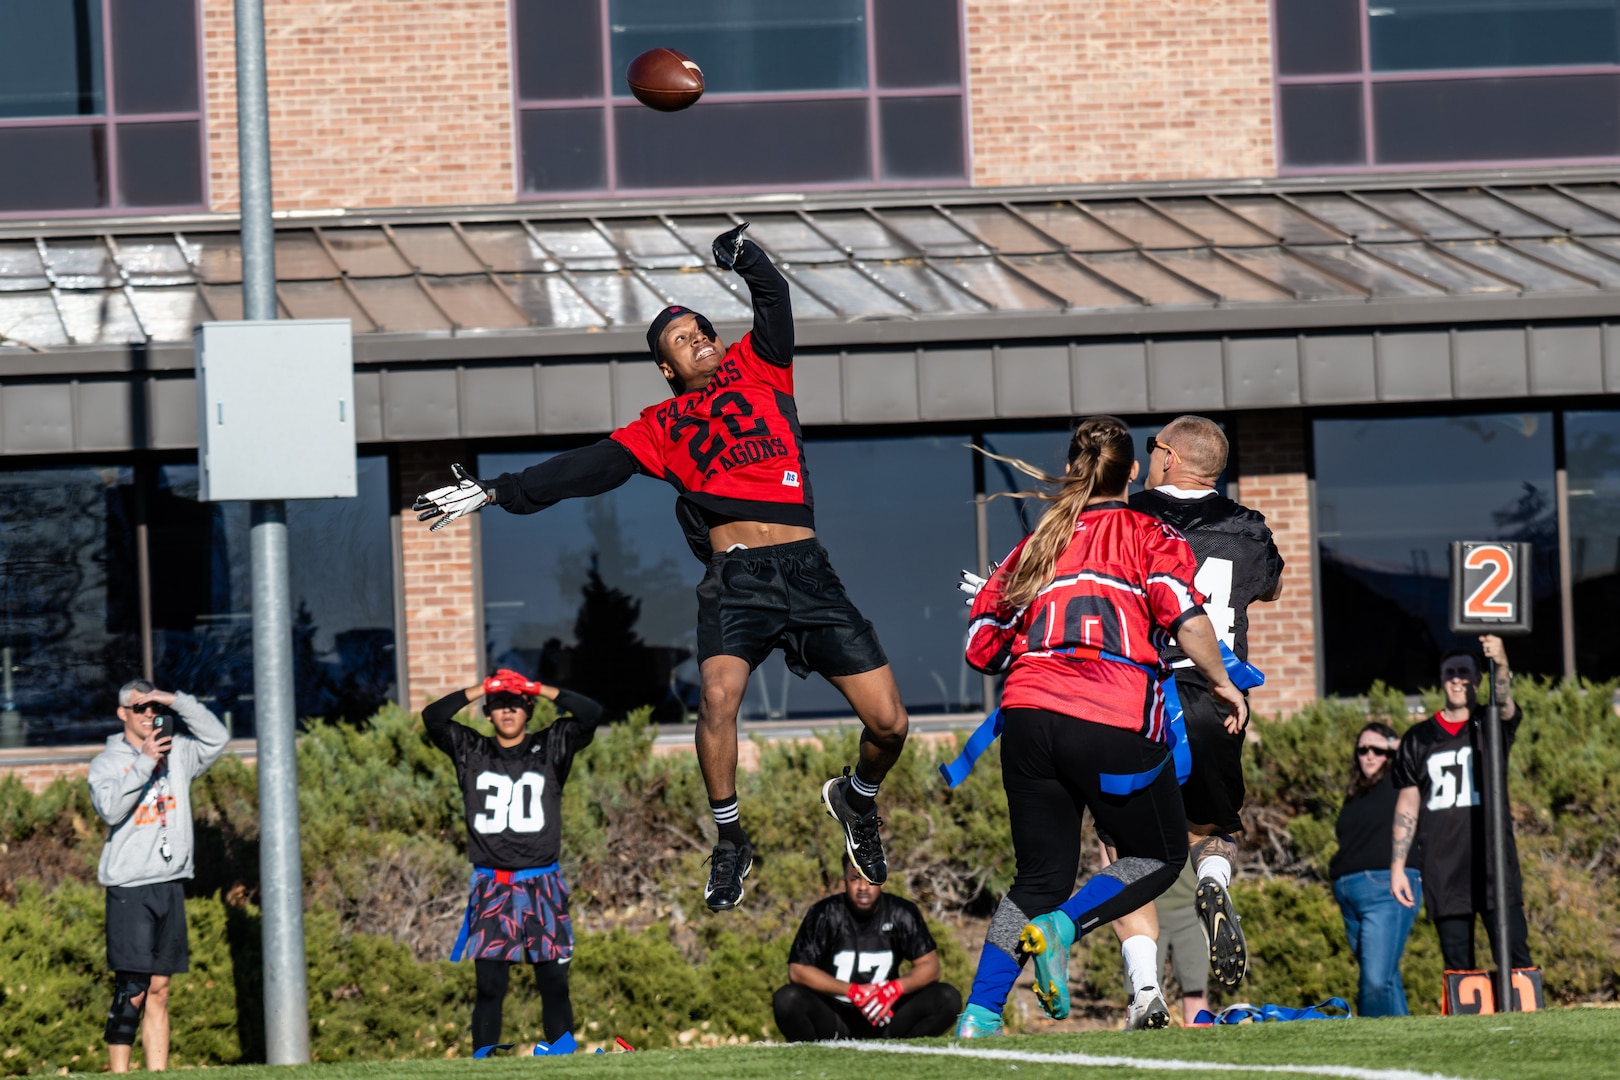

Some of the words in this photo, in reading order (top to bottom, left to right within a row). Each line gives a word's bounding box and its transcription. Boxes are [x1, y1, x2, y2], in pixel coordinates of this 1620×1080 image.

[670, 391, 771, 474] 22
[702, 437, 788, 487] AGONS
[1464, 545, 1514, 618] 2
[473, 770, 545, 834] 30
[1426, 746, 1480, 811] 61
[832, 949, 894, 1003] 17
